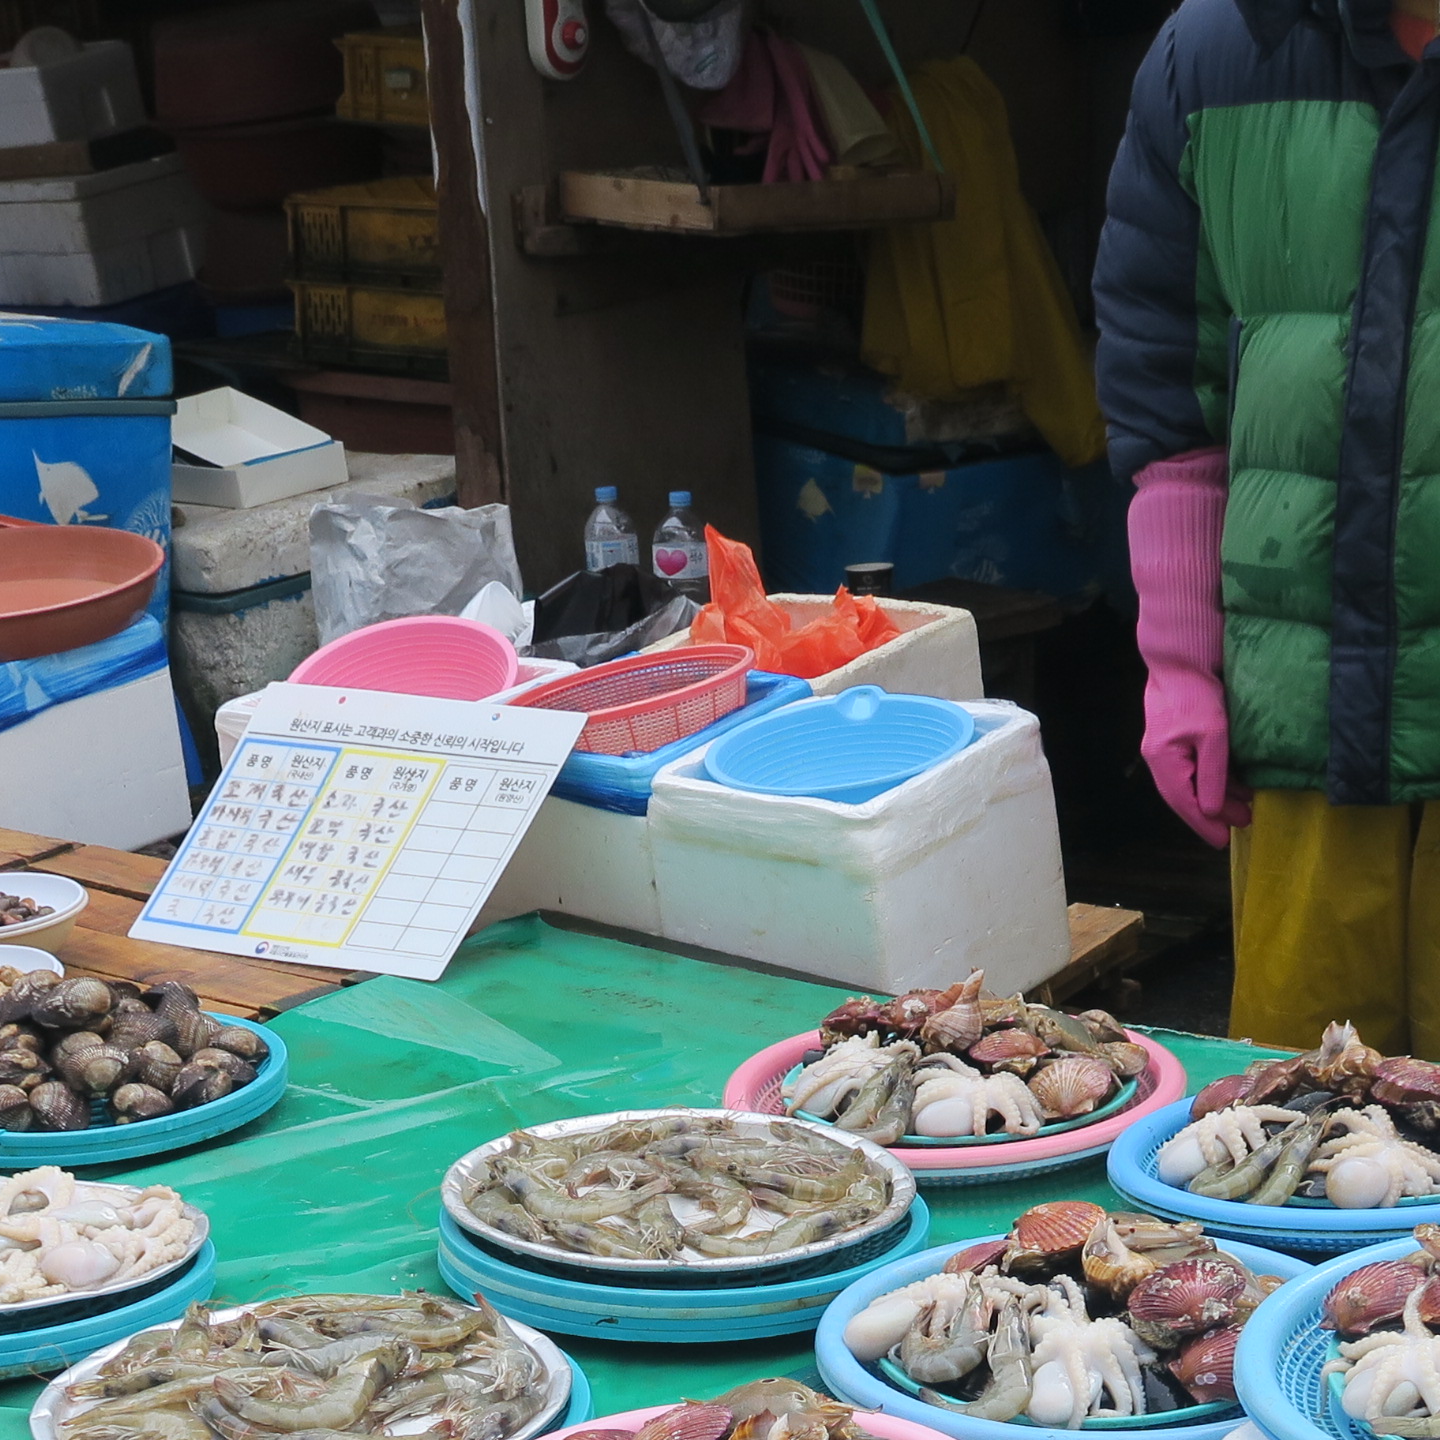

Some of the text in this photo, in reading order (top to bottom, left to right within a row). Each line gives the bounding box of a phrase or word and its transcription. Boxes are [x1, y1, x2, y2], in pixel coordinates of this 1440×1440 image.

[289, 718, 525, 755] 원산지 표시는 고객과의 소중한 신뢰의 시작입니다
[290, 754, 327, 769] 원산지
[286, 771, 314, 781] (국내산)
[392, 766, 429, 782] 원산지
[389, 781, 417, 792] (국가명)
[499, 777, 537, 794] 원산지
